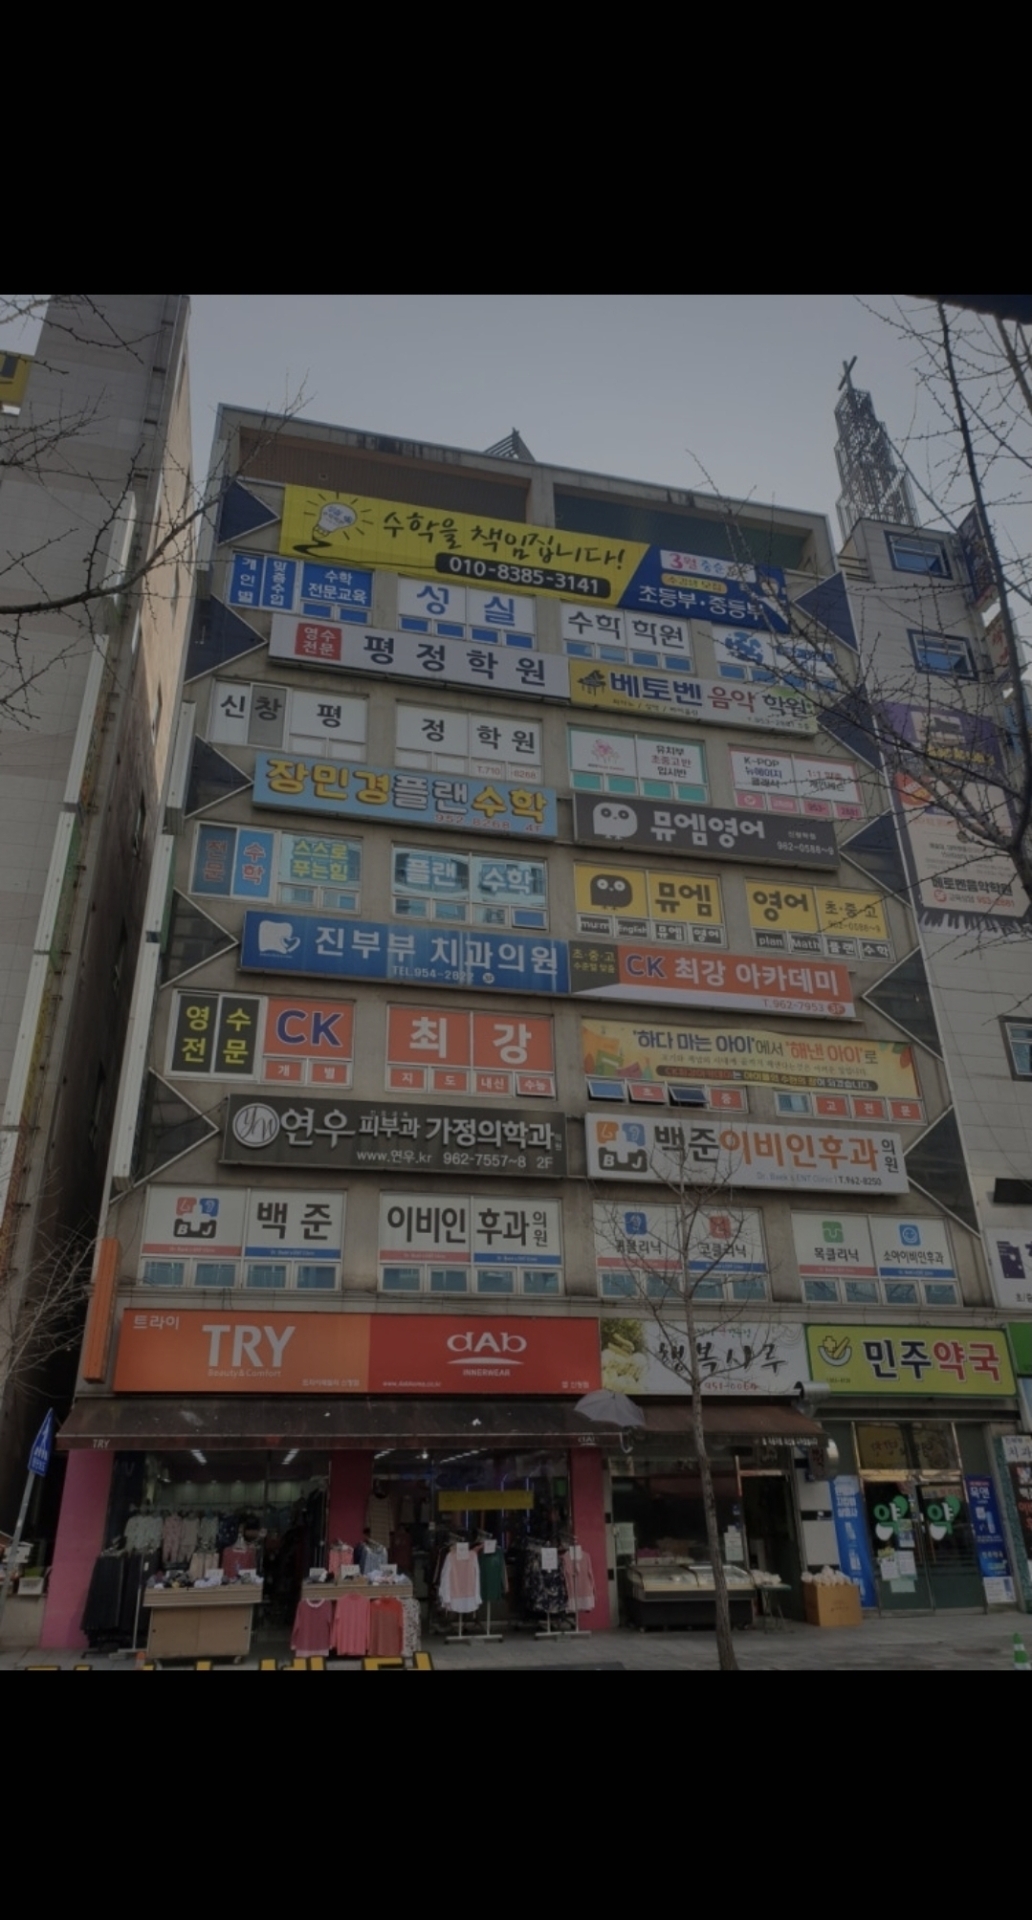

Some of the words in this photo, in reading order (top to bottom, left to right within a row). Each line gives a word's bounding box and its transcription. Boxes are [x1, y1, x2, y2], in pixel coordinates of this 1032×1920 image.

[383, 511, 461, 550] 수학을
[470, 525, 625, 570] 책임집니다!
[324, 569, 353, 586] 수학
[449, 556, 600, 594] 010-8385-3141
[308, 582, 368, 605] 전문교육
[304, 626, 336, 642] 영수
[568, 611, 621, 640] 수학
[631, 619, 685, 650] 학원
[303, 641, 335, 658] 전문
[609, 672, 702, 707] 베토벤
[707, 685, 757, 714] 음악
[762, 694, 808, 719] 학원
[744, 756, 779, 768] K-POP
[651, 810, 766, 849] 뮤엠영어
[292, 839, 350, 861] 스스로
[241, 841, 266, 886] 수학
[655, 881, 713, 918] 뮤엠
[752, 890, 809, 922] 영어
[314, 925, 417, 962] 진부부
[430, 936, 559, 976] 치과의원
[758, 935, 783, 947] plan
[792, 938, 821, 949] Math
[625, 953, 667, 980] CK
[674, 956, 726, 988] 최강
[735, 963, 839, 997] 아카데미
[762, 999, 825, 1013] T.962-7953
[276, 1008, 344, 1048] CK
[676, 1032, 713, 1052] 마는
[481, 1076, 505, 1091] 내신
[280, 1107, 356, 1149] 연우
[359, 1115, 421, 1139] 피부과
[425, 1117, 555, 1151] 가정의학과
[357, 1150, 433, 1164] www.연우.kr
[443, 1152, 527, 1168] 962-7557~8
[536, 1156, 554, 1169] 2F
[814, 1247, 860, 1262] 목클리닉
[883, 1250, 945, 1265] 소아이비인후과
[133, 1315, 180, 1330] 트라이
[202, 1324, 296, 1367] TRY
[863, 1338, 1001, 1382] 민주약국
[463, 1368, 511, 1377] INNERWEAR
[92, 1438, 110, 1449] TRY
